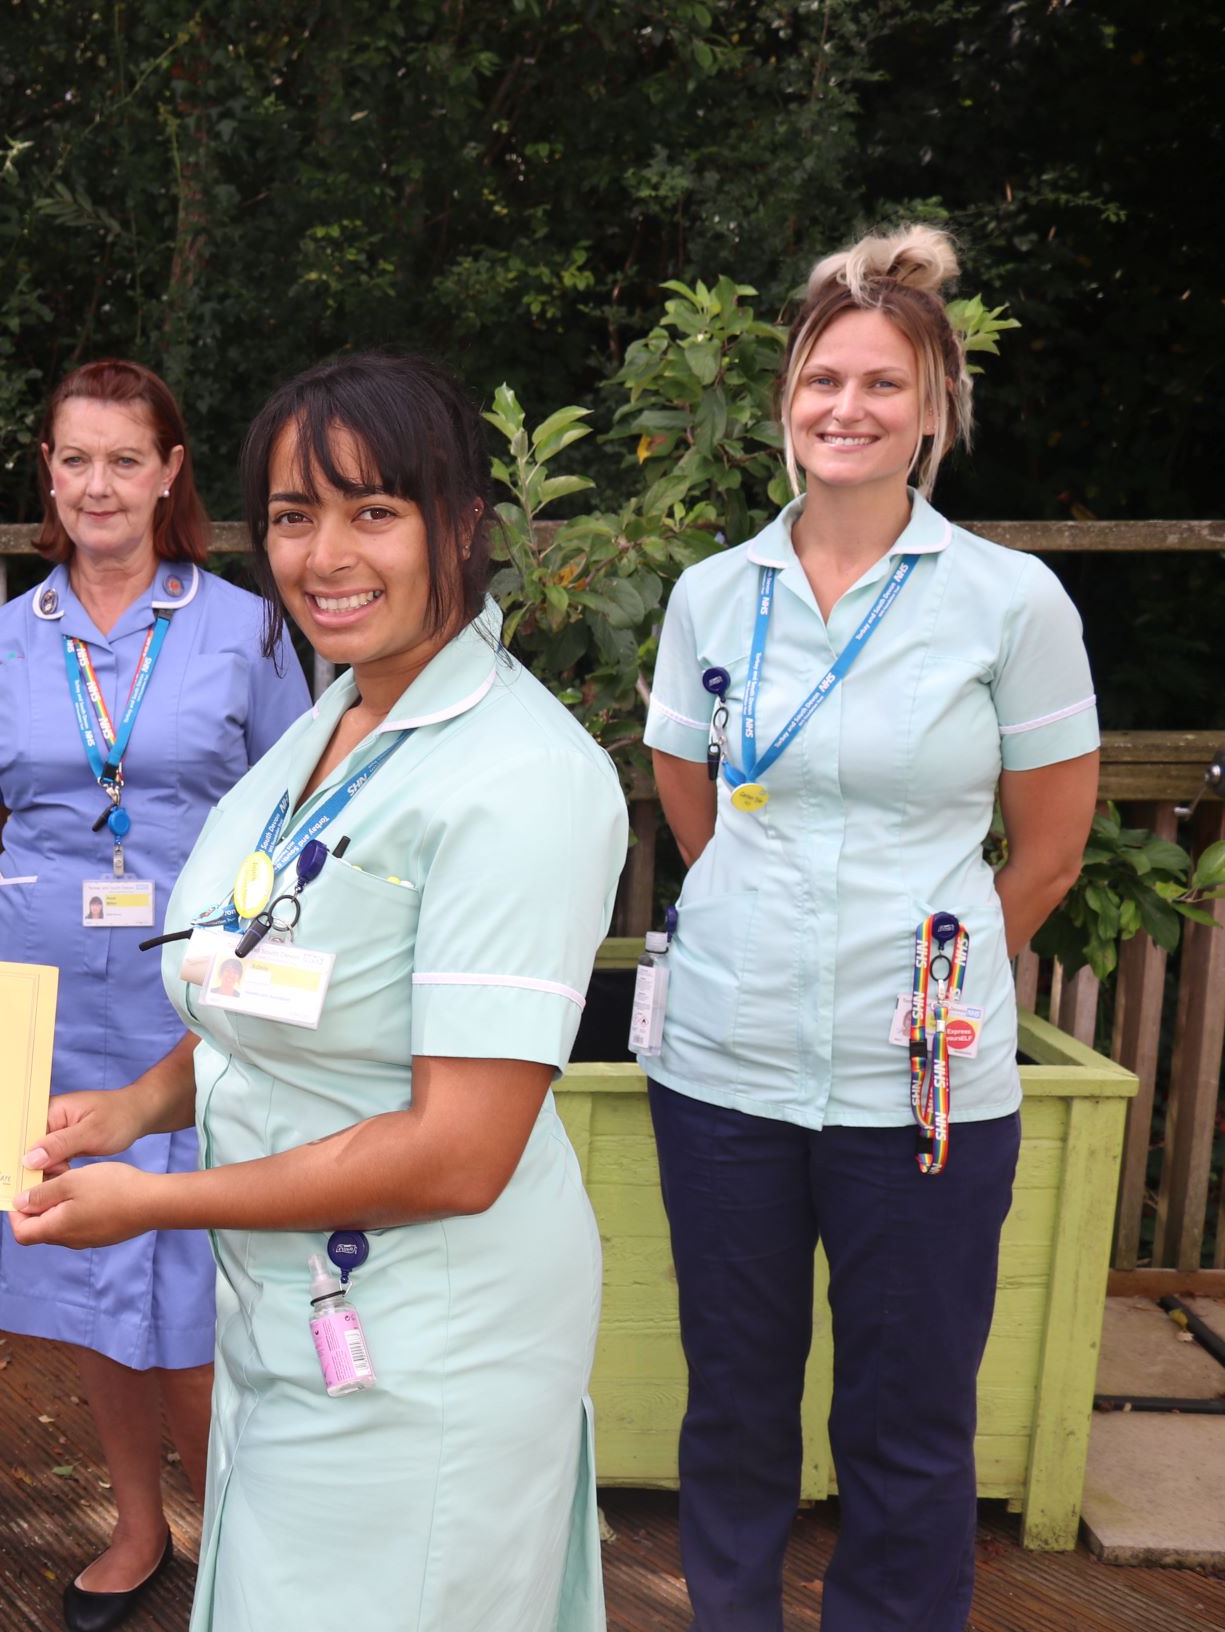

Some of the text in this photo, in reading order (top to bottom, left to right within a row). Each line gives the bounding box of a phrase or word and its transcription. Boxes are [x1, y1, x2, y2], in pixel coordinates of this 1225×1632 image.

[893, 562, 909, 582] NHS
[760, 597, 769, 615] NHS
[76, 647, 90, 667] NHS
[141, 657, 152, 672] NHS
[87, 681, 101, 702] NHS
[819, 672, 835, 692] NHS
[85, 730, 95, 746] NHS
[99, 717, 115, 739] NHS
[745, 717, 754, 738] NHS
[347, 773, 368, 797] NHS
[261, 813, 280, 849] South Devon
[309, 815, 330, 835] Torbay
[297, 833, 310, 846] and
[916, 940, 929, 968] NHS
[955, 937, 969, 966] NHS
[912, 991, 925, 1019] NHS
[967, 1008, 981, 1018] NHS
[934, 1059, 946, 1089] NHS
[912, 1080, 922, 1106] NHS
[935, 1112, 947, 1141] NHS
